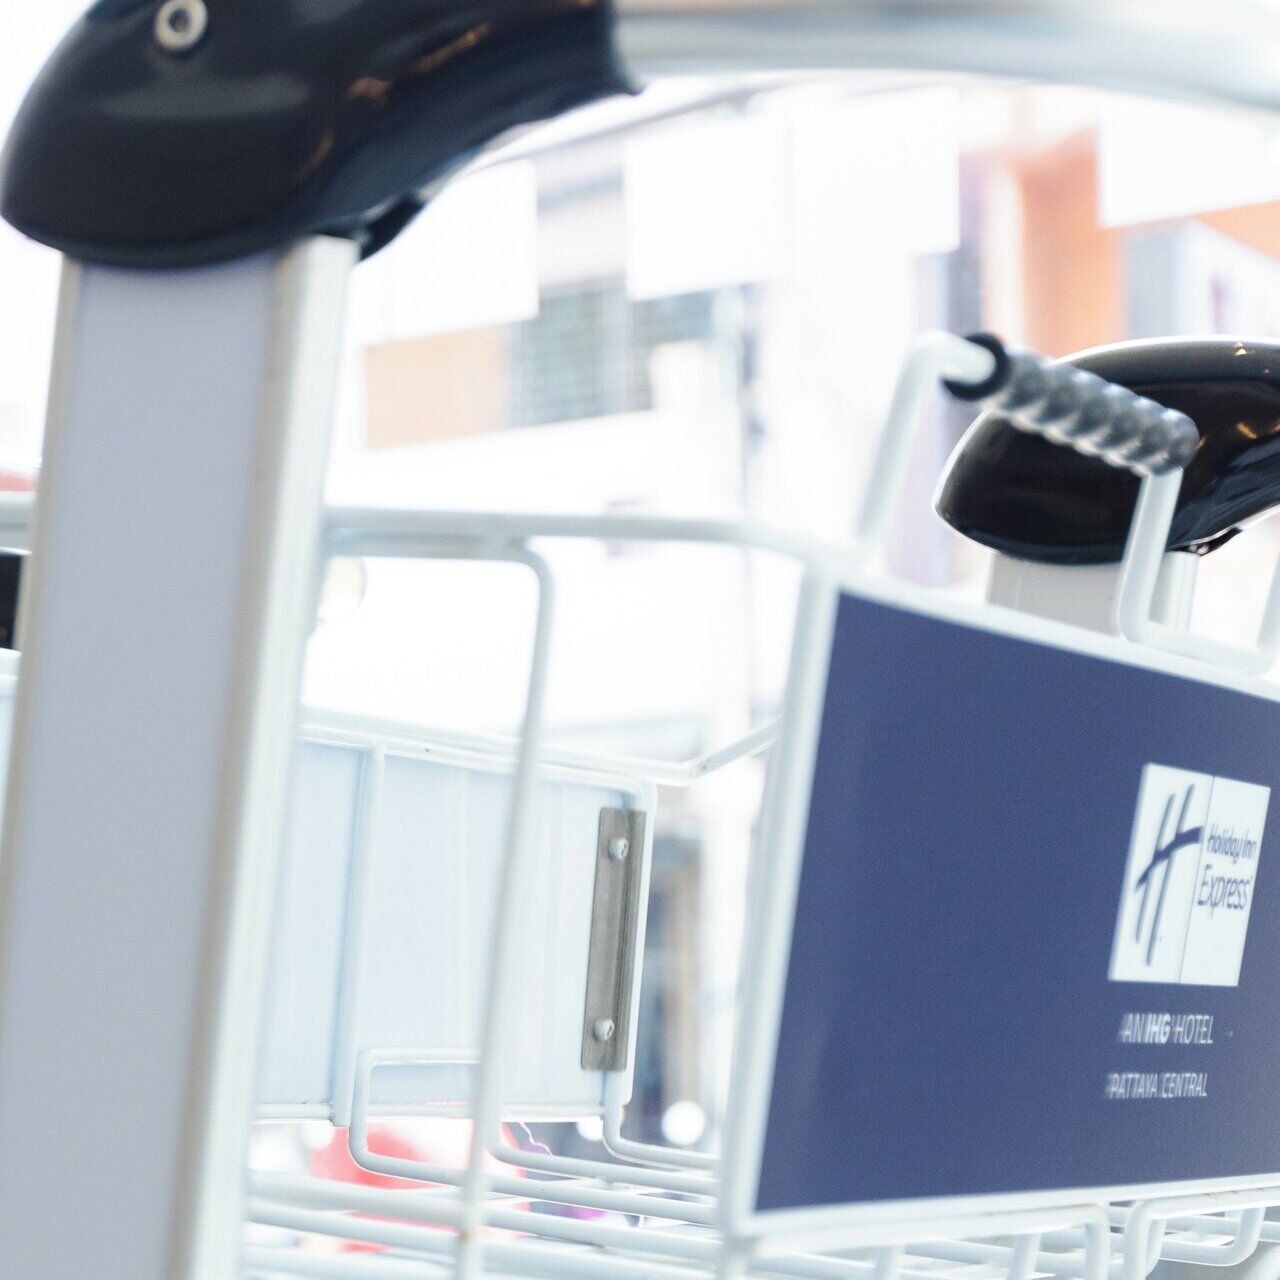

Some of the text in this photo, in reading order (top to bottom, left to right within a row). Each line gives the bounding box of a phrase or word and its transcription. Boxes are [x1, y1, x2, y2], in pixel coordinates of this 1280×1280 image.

[1172, 1013, 1214, 1045] HOTEL
[1105, 1072, 1208, 1099] PATTAYA CENTRAL
